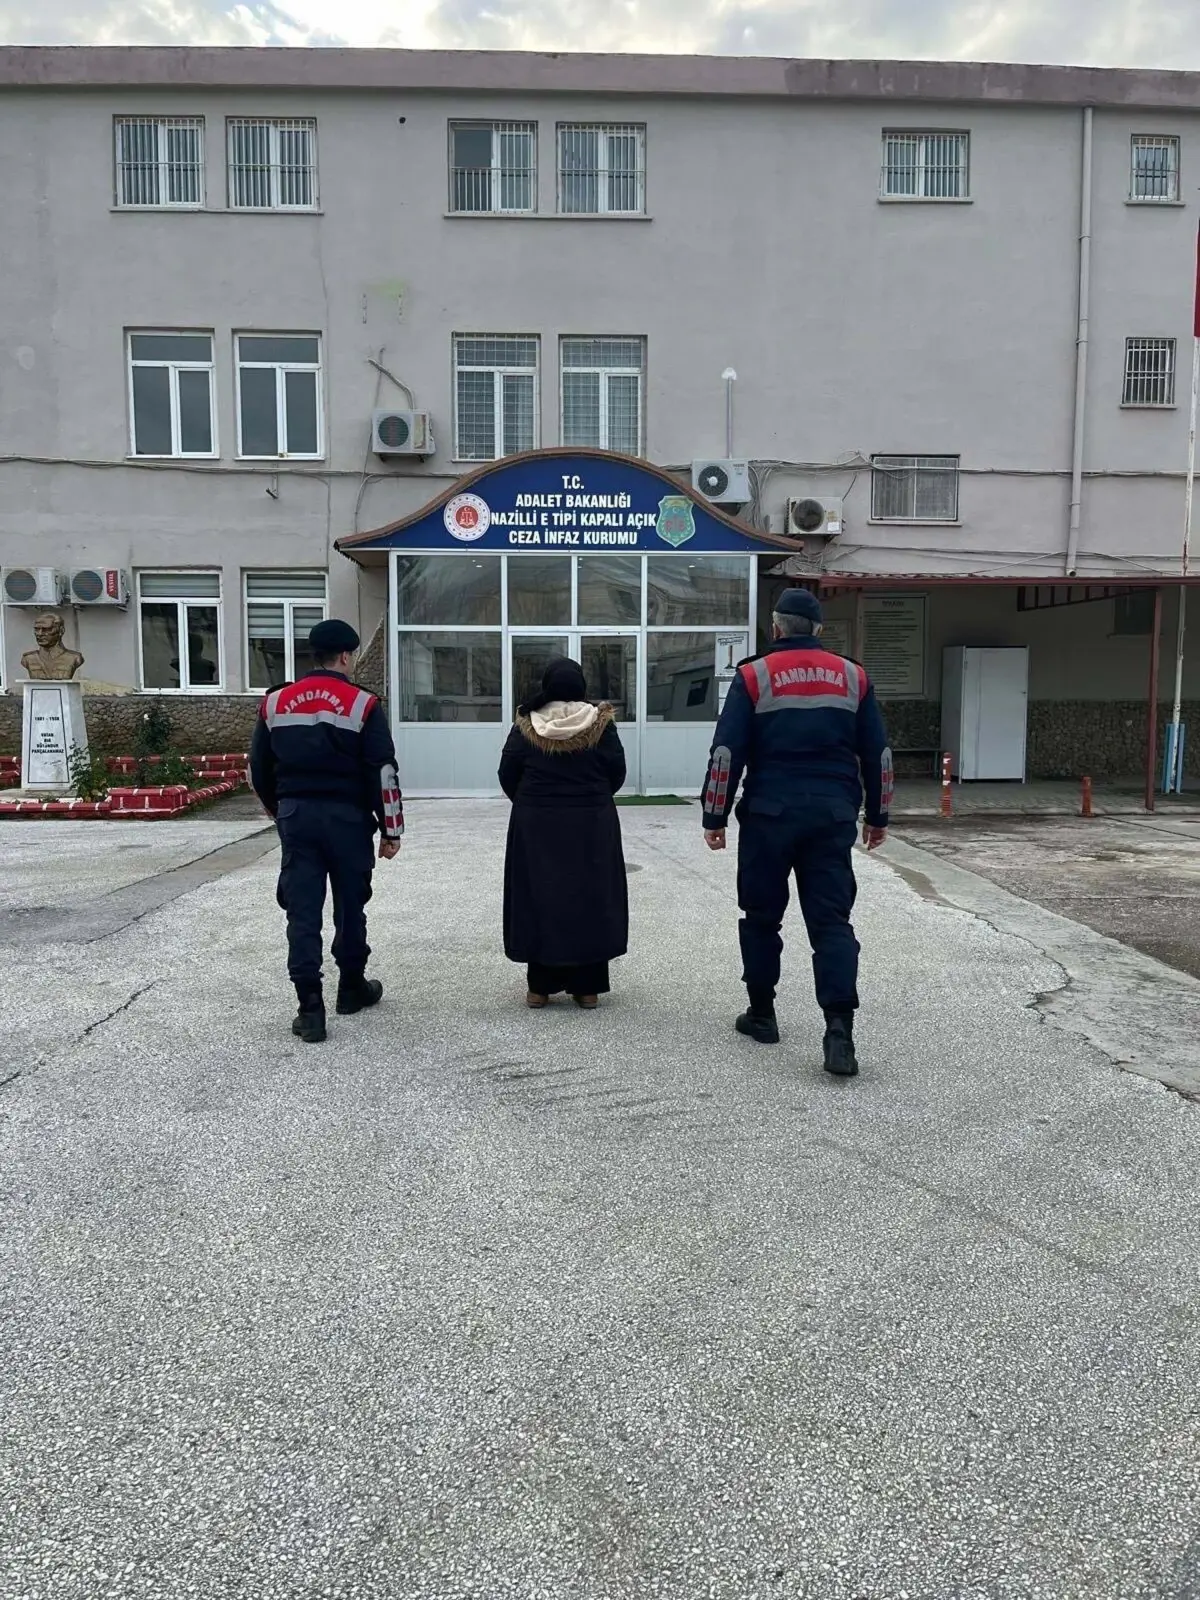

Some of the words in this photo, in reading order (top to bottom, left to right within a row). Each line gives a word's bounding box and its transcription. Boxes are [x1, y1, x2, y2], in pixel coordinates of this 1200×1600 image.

[562, 475, 585, 489] T.C.
[515, 494, 563, 508] ADALET
[566, 492, 631, 508] BAKANLIĞI
[491, 510, 537, 526] NAZİLLİ
[541, 513, 548, 526] E
[552, 511, 576, 526] TİPİ
[581, 513, 623, 526] KAPALI
[627, 513, 656, 530] AÇIK
[509, 531, 540, 544] CEZA
[544, 529, 580, 544] İNFAZ
[584, 531, 637, 545] KURUMU
[773, 666, 844, 688] JANDARMA
[284, 689, 344, 715] JANDARMA
